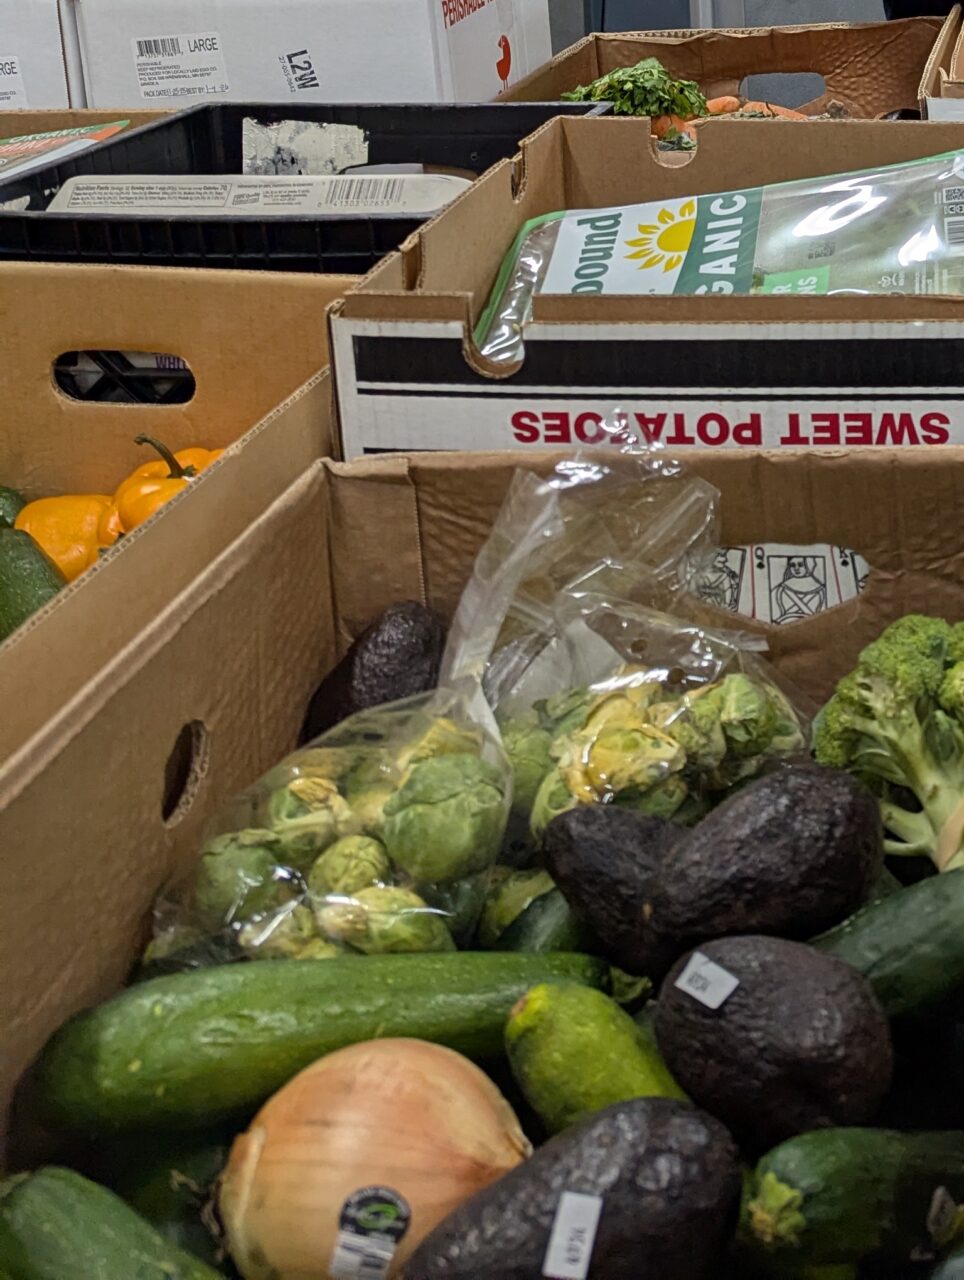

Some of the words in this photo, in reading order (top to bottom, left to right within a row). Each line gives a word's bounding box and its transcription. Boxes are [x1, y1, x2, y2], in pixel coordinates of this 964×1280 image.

[188, 37, 218, 53] LARGE
[286, 49, 319, 89] L2W
[513, 410, 762, 445] POTATOES
[781, 412, 950, 445] SWEET
[755, 547, 765, 560] Q
